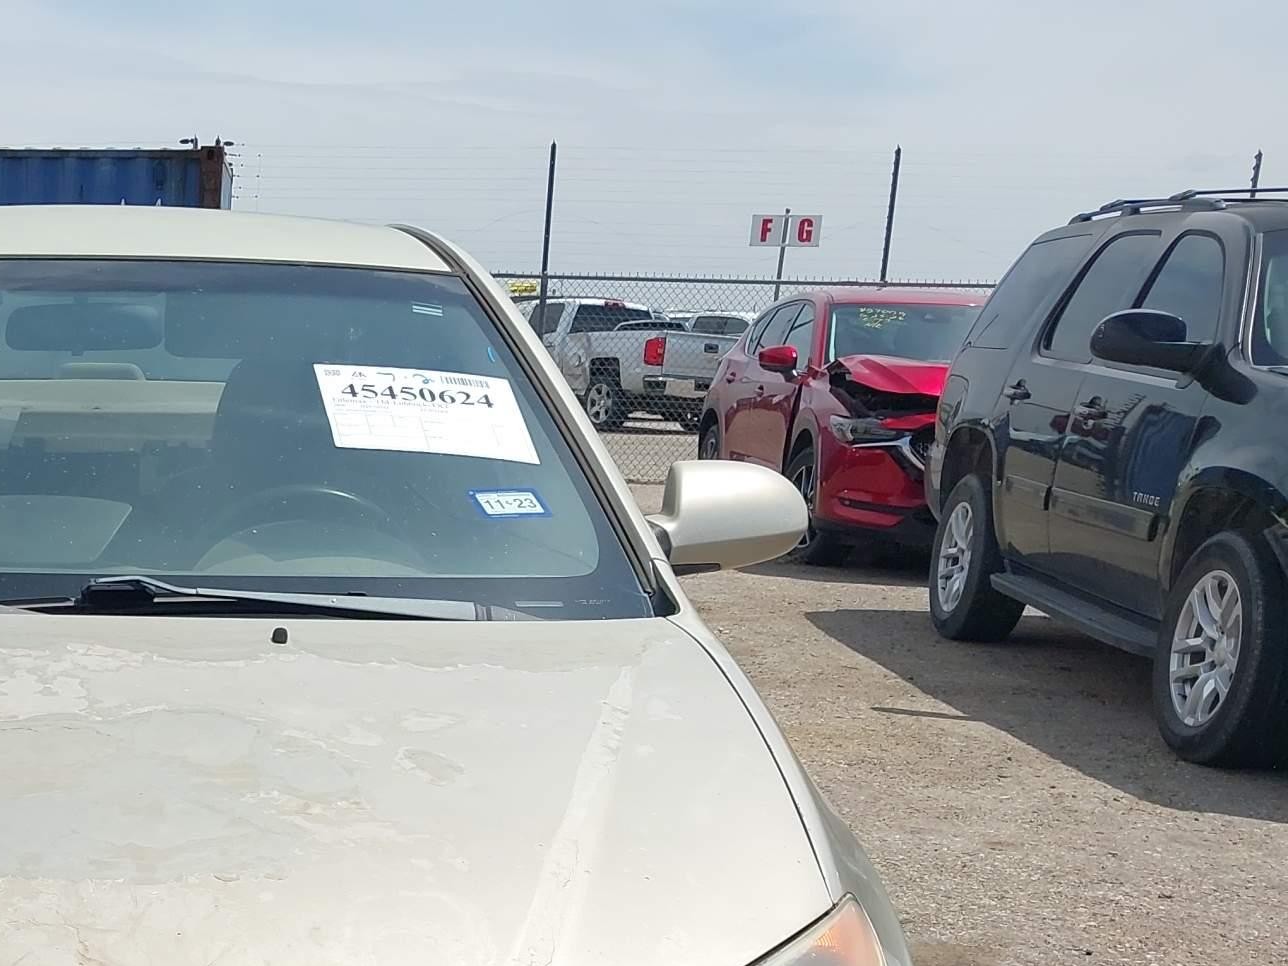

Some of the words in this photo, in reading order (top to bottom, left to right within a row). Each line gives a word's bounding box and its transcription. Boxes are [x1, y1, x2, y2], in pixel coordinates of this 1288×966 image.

[760, 218, 773, 242] F
[798, 218, 813, 242] G
[341, 383, 494, 408] 45450624
